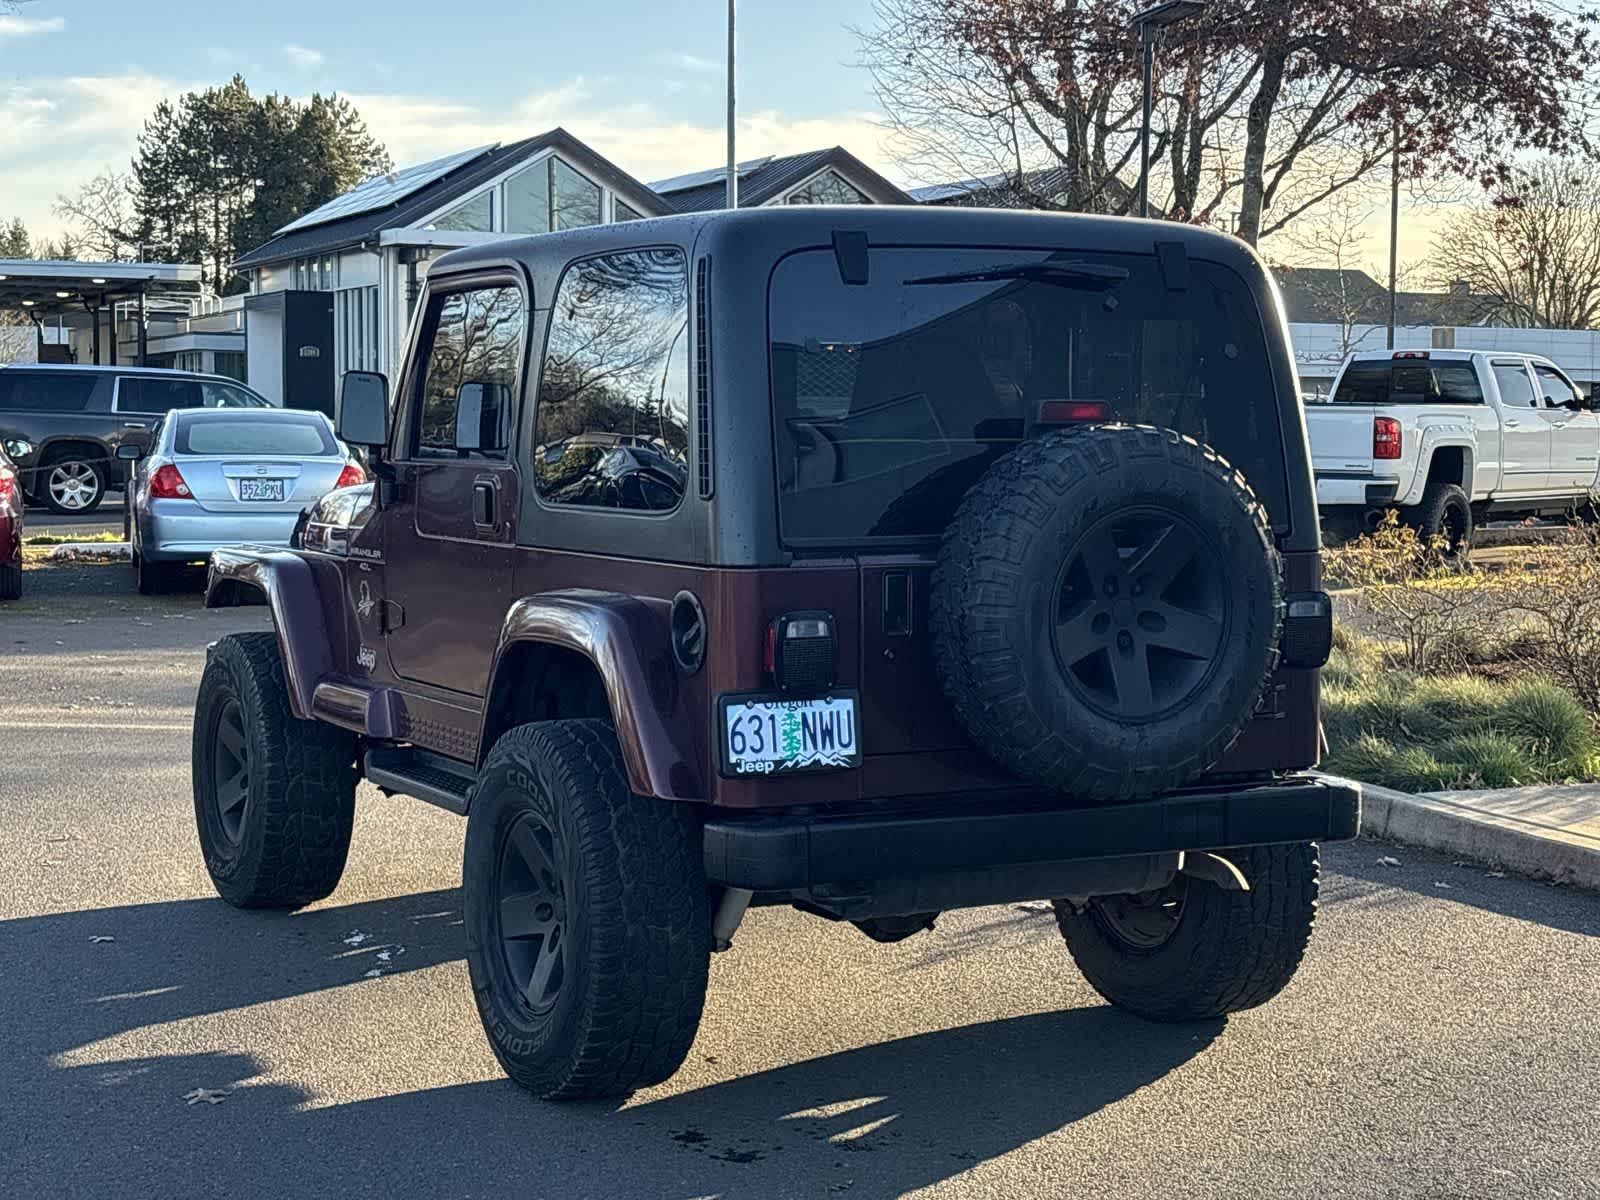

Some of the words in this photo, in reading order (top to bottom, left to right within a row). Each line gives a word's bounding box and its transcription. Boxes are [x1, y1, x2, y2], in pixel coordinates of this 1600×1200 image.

[243, 484, 260, 496] 352
[264, 484, 282, 496] PKU
[356, 646, 376, 672] Jeep
[730, 714, 778, 755] 631
[800, 710, 852, 752] NWU
[736, 758, 775, 774] Jeep
